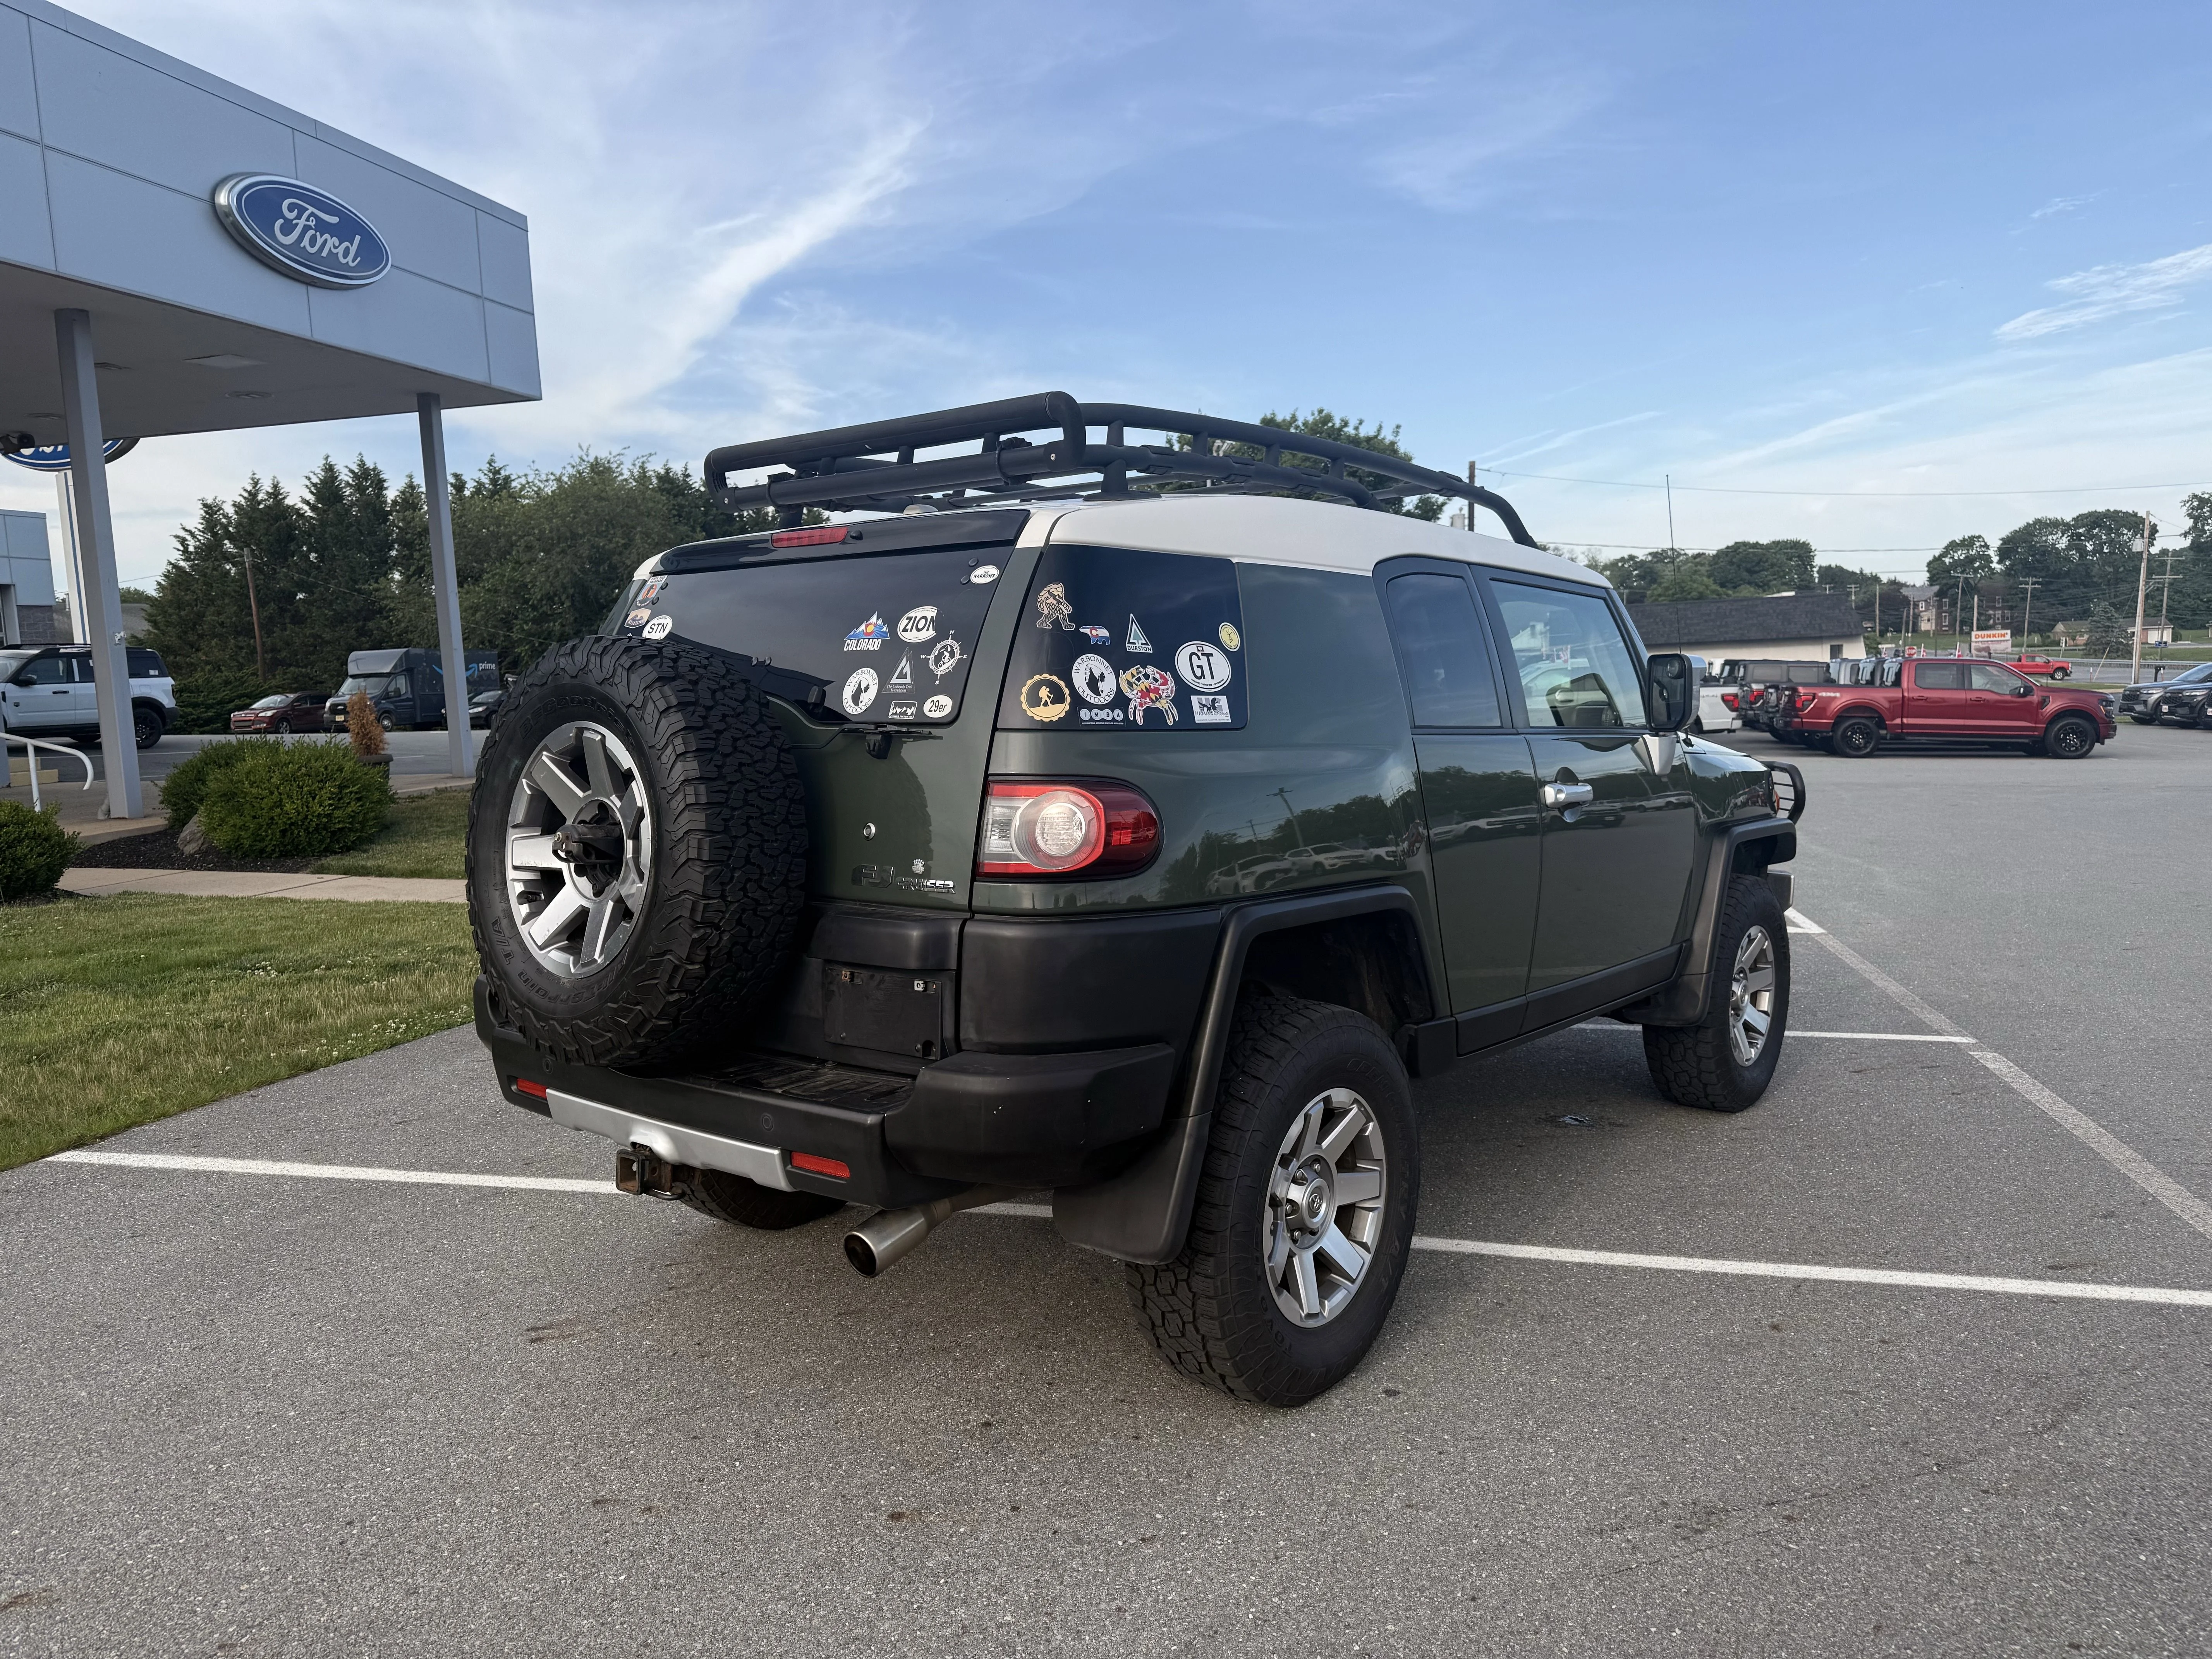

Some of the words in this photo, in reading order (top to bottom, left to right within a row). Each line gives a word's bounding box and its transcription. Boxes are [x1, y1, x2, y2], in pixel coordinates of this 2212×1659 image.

[274, 198, 361, 266] Ford
[648, 622, 668, 634] STN
[843, 639, 882, 651] COLORADO
[479, 661, 496, 671] prime
[1074, 656, 1113, 675] WARBONNET
[1189, 652, 1214, 680] GT
[846, 669, 877, 687] WARBONNET
[1078, 686, 1114, 703] OUTDOORS
[843, 697, 872, 713] OUTDOORS
[928, 700, 947, 713] 29er
[852, 864, 895, 888] FJ
